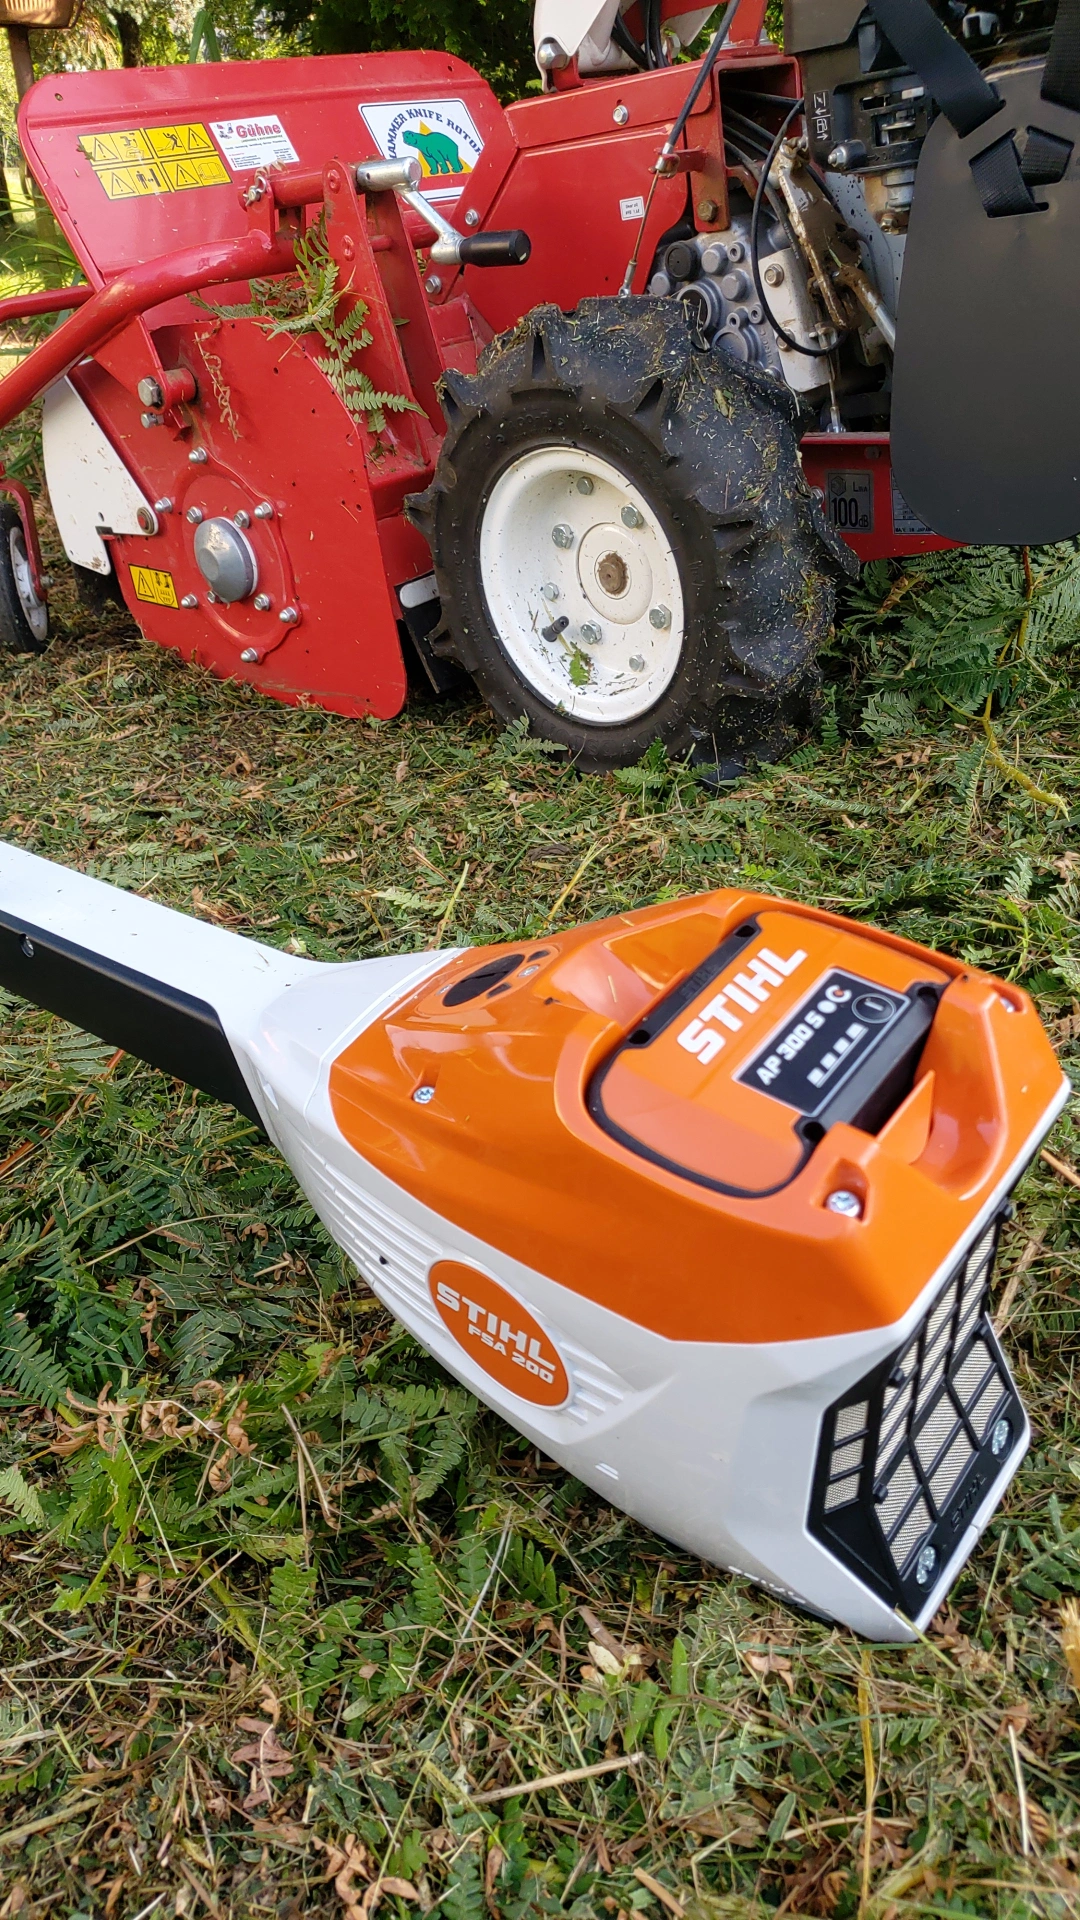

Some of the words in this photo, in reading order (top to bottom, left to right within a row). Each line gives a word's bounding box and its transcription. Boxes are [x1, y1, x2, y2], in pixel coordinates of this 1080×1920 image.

[236, 122, 282, 139] Gühne
[405, 108, 443, 123] KNIFE
[831, 497, 858, 527] 100
[859, 514, 869, 528] dB
[676, 947, 808, 1065] STIHL
[756, 1059, 782, 1086] AP
[776, 1022, 815, 1062] 300
[804, 1009, 826, 1030] S
[437, 1281, 556, 1371] STIHL
[468, 1323, 507, 1356] FSA
[511, 1351, 554, 1384] 200
[951, 1474, 987, 1533] STIHL
